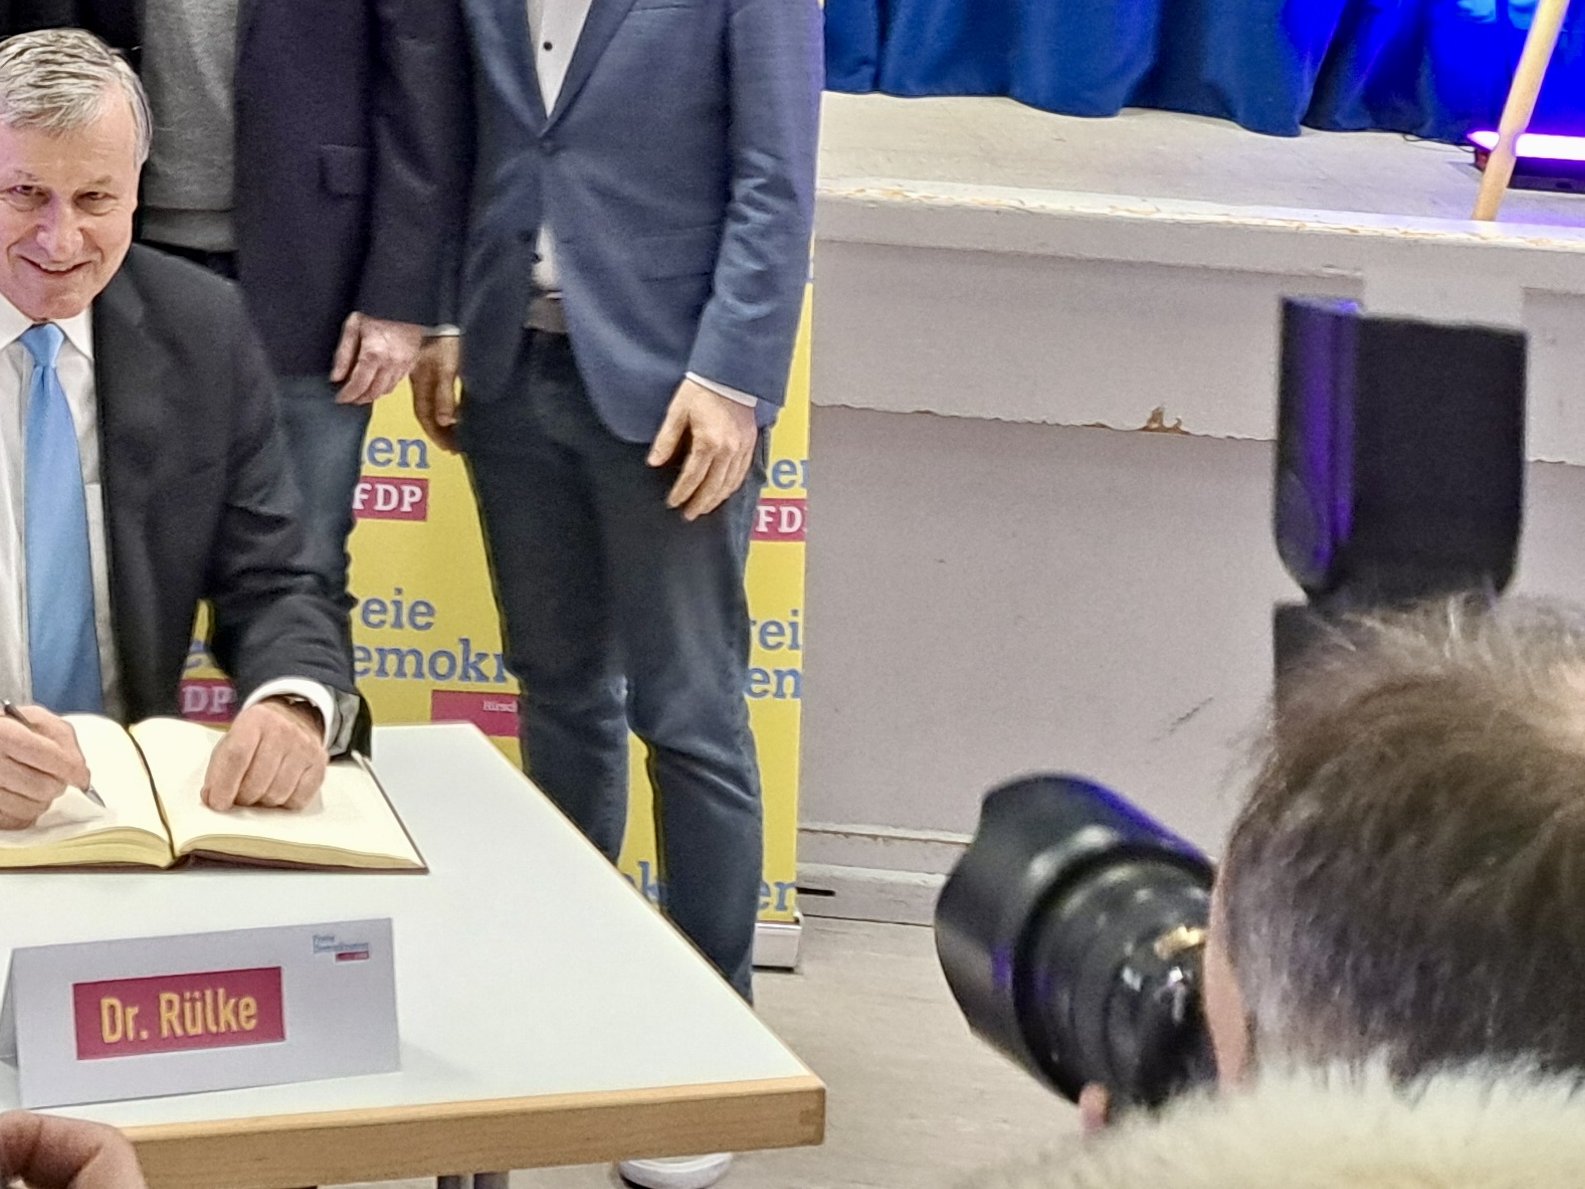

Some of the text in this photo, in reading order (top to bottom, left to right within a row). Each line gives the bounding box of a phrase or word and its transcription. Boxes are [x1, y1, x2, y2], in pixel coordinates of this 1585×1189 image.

[353, 483, 423, 512] FDP
[756, 505, 807, 532] FD
[182, 685, 233, 713] DP
[100, 988, 258, 1044] Dr. Rülke
